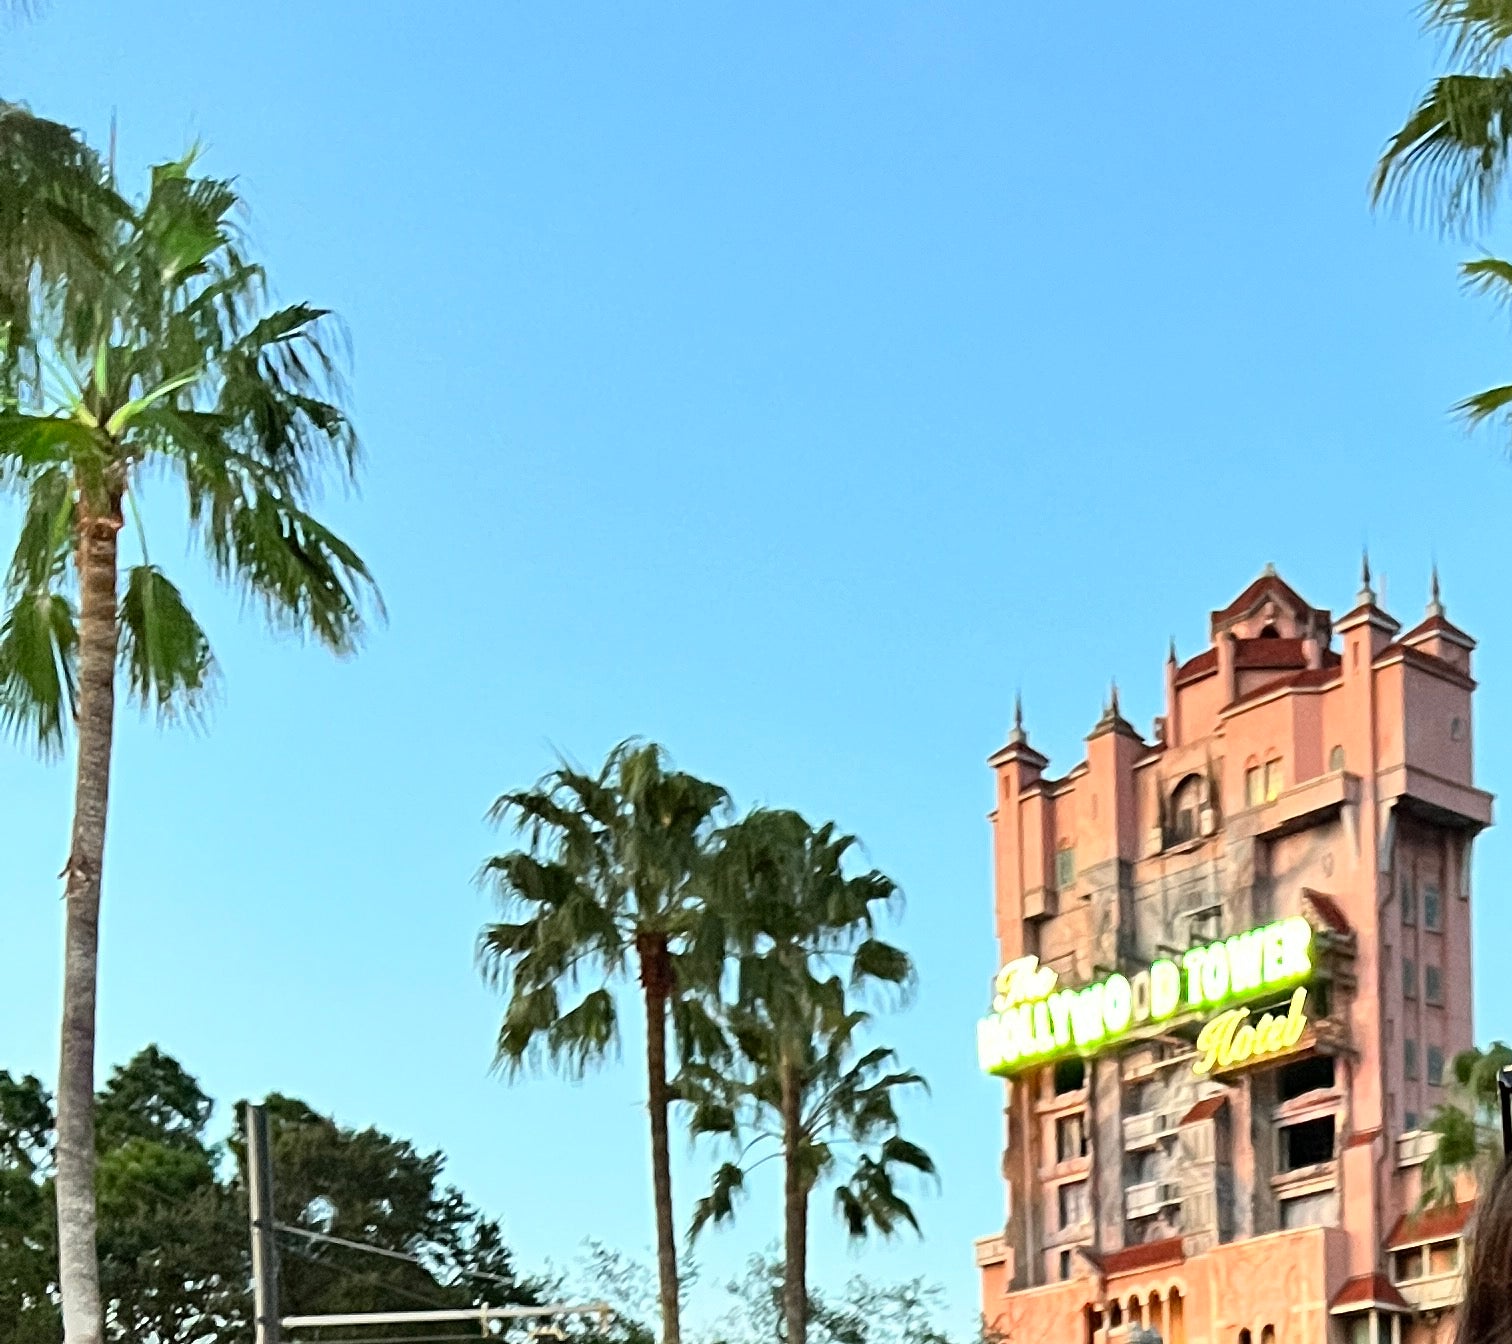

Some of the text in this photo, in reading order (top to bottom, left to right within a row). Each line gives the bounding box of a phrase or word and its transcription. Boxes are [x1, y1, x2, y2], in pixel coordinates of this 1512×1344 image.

[977, 916, 1312, 1071] HOLLYWOOD TOWER
[993, 955, 1058, 1012] The
[1192, 986, 1307, 1074] Hotel
